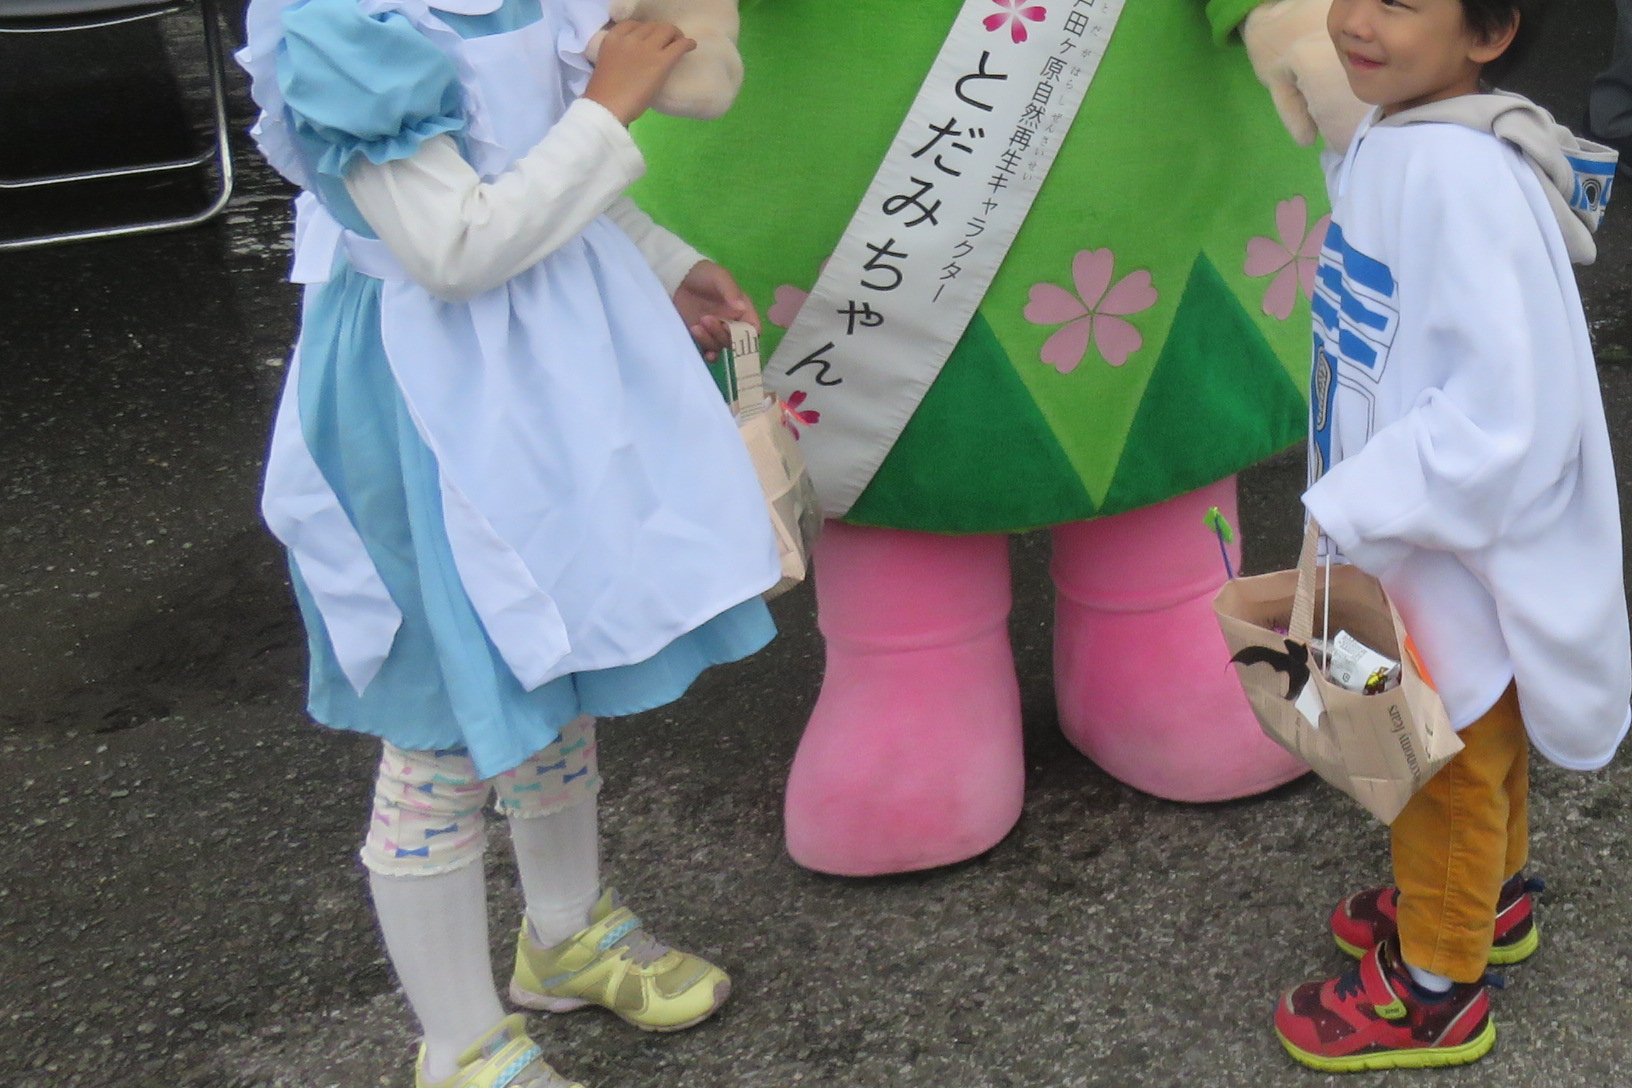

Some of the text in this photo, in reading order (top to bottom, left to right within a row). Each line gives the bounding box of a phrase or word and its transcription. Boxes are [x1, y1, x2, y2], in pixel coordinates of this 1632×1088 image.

[785, 49, 1009, 388] とだみちゃん
[1386, 703, 1407, 734] fears
